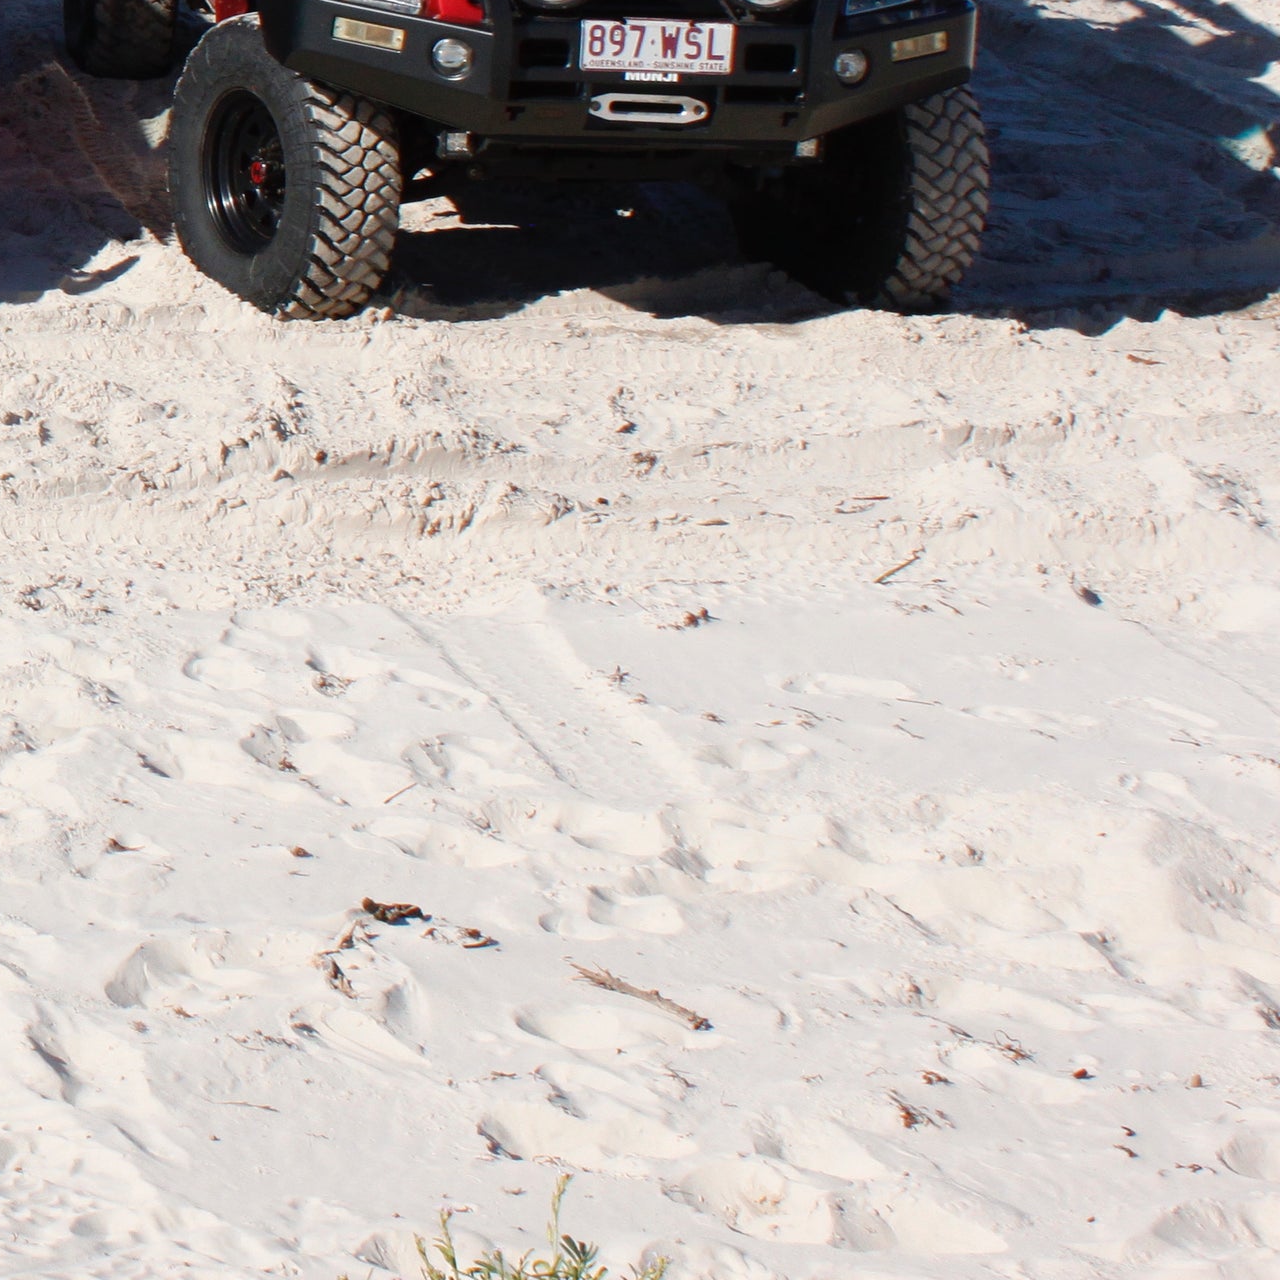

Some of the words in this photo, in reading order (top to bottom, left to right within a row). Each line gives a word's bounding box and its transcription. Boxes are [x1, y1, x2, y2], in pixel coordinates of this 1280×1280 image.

[589, 59, 644, 68] QUEENSLAND
[653, 61, 695, 70] SUNSHINE
[698, 62, 724, 71] STATE
[624, 72, 679, 82] MUNJI
